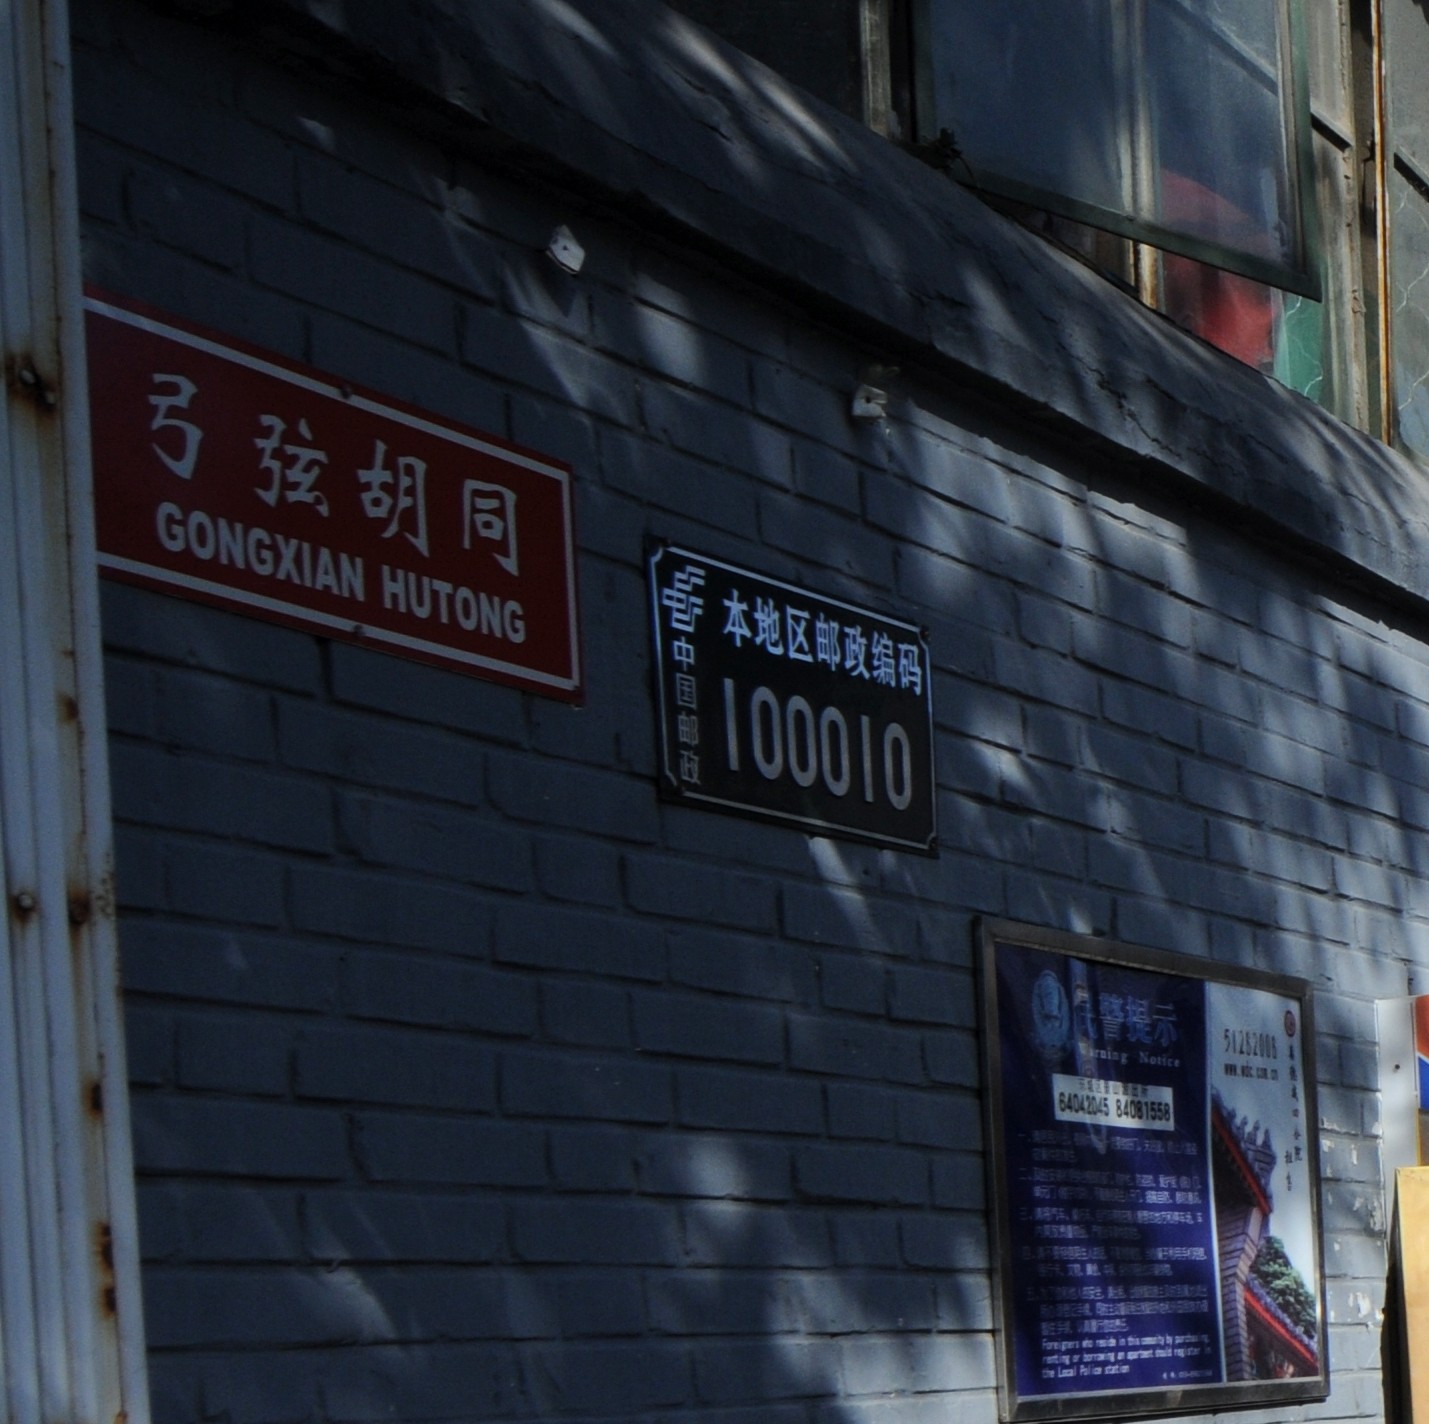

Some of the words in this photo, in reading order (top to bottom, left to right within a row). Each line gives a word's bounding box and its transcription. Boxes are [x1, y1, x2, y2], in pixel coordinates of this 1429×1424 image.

[148, 373, 519, 577] 弓弦胡同
[156, 501, 365, 601] GONGXIAN
[381, 564, 526, 643] HUTONG
[722, 588, 922, 696] 本地区邮政编码
[672, 636, 702, 786] 中国邮政
[724, 677, 912, 810] 100010
[1139, 1050, 1181, 1068] Notice
